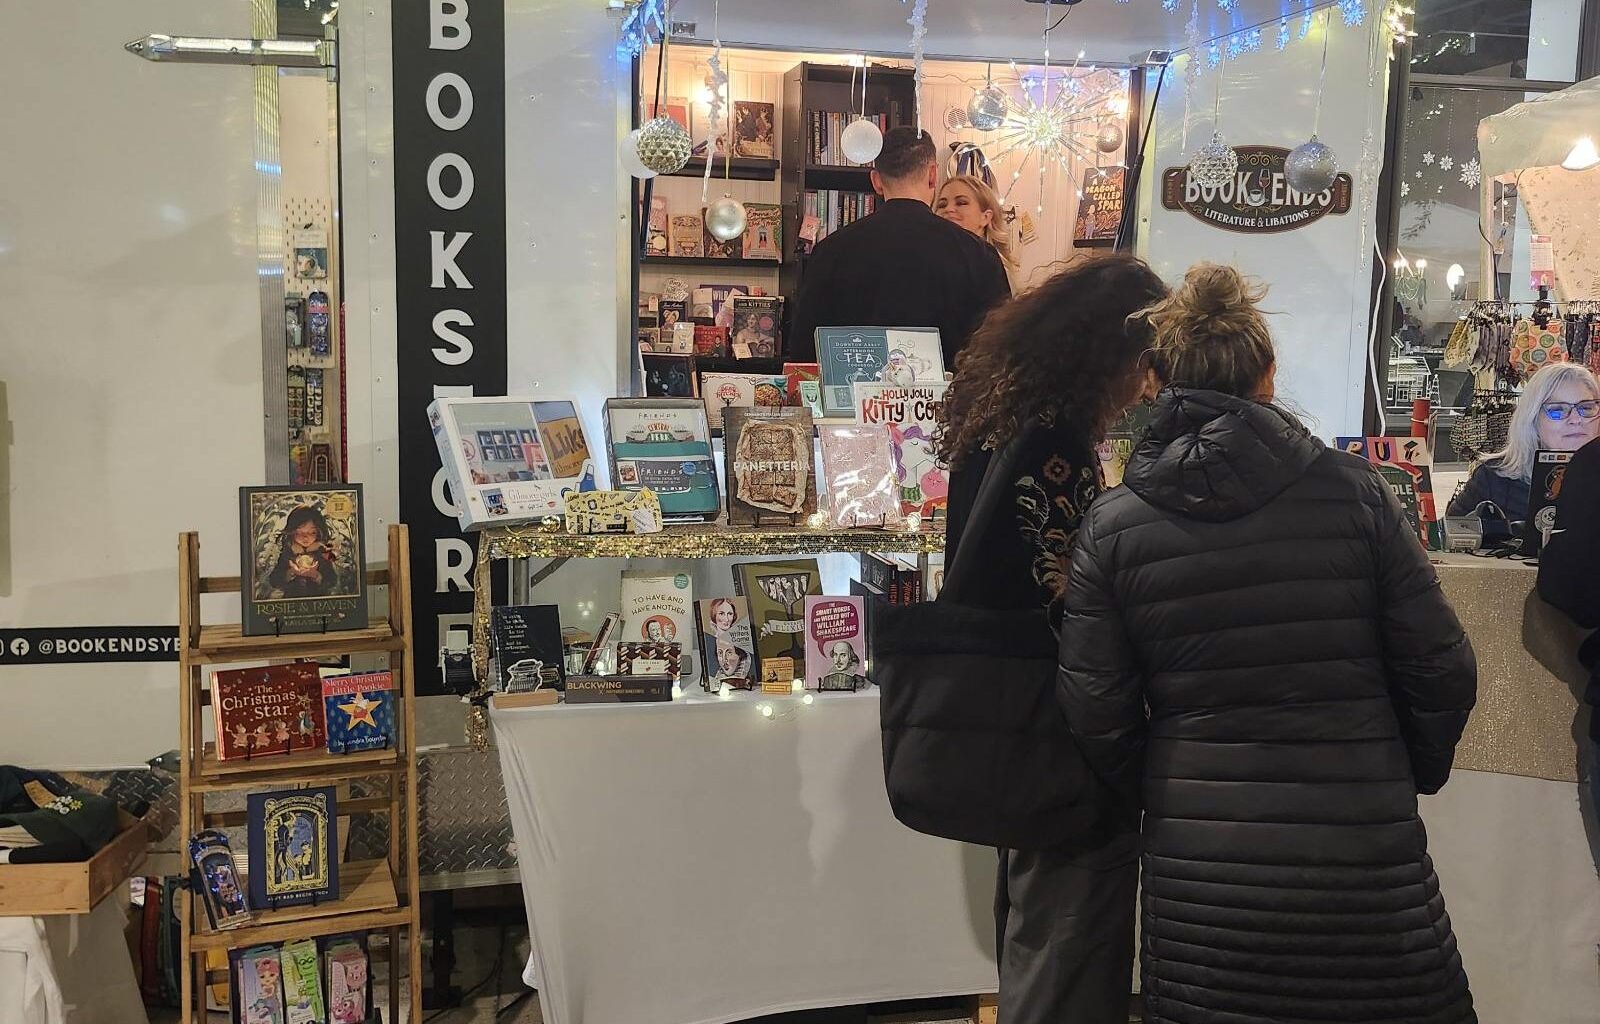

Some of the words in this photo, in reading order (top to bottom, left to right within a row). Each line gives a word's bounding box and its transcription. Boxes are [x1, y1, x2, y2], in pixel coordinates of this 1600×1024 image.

[1184, 170, 1254, 204] BOOK
[1093, 192, 1120, 200] CALLED
[1097, 200, 1121, 211] SPAR
[1204, 208, 1256, 227] LITERATURE
[1257, 217, 1264, 227] &
[1265, 210, 1309, 227] LIBATIONS
[425, 0, 475, 668] BOOKSR
[843, 353, 876, 363] TEA
[882, 388, 908, 402] HOLLY
[910, 388, 934, 402] JOLLY
[733, 461, 811, 471] PANETTERIA
[667, 596, 684, 604] AND
[257, 602, 296, 615] ROSIE
[313, 599, 356, 612] RAVEN
[632, 605, 651, 615] HAVE
[652, 604, 686, 615] ANOTHER
[816, 608, 832, 616] SMART
[816, 619, 845, 630] WILLIAM
[816, 624, 857, 636] SHAKESPEARE
[325, 678, 349, 687] Merry
[567, 681, 622, 690] BLACKWING
[254, 685, 273, 694] The
[332, 685, 355, 695] Little
[357, 683, 385, 692] Pookie
[222, 690, 296, 711] Christmas
